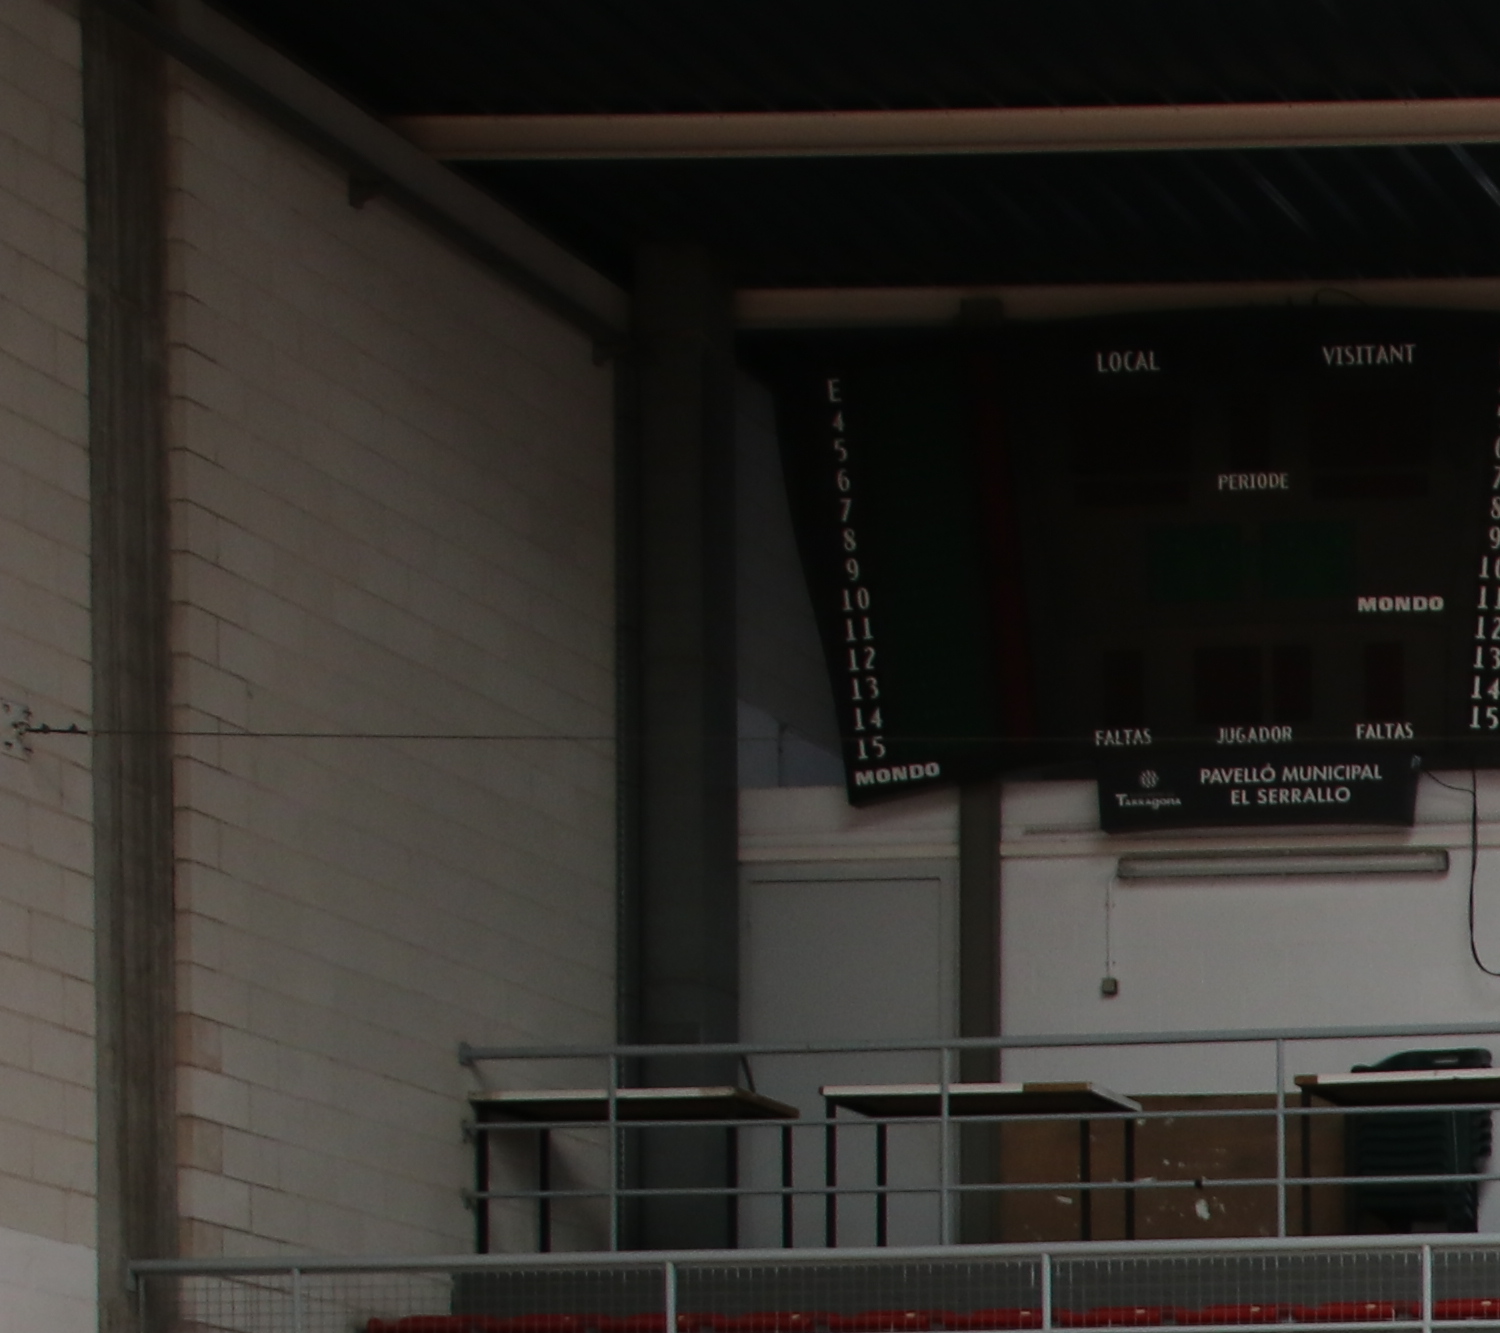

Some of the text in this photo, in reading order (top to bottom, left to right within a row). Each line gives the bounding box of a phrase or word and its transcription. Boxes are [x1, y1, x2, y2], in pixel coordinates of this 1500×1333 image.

[1097, 351, 1160, 373] LOCAL
[1322, 344, 1415, 366] VISITANT
[827, 379, 841, 402] E
[832, 411, 845, 432] 4
[833, 438, 848, 462] 5
[837, 469, 851, 492] 6
[1218, 473, 1289, 491] PERIODE
[840, 498, 852, 522] 7
[843, 528, 857, 552] 8
[845, 558, 860, 581] 9
[843, 587, 870, 611] 10
[1357, 596, 1444, 612] MONDO
[846, 617, 874, 642] 11
[849, 646, 876, 672] 12
[852, 676, 880, 700] 13
[1471, 675, 1500, 700] 14
[855, 707, 883, 731] 14
[1469, 705, 1499, 729] 15
[1095, 728, 1152, 746] FALTAS
[1217, 725, 1293, 744] JUGADOR
[1356, 722, 1414, 740] FALTAS
[858, 735, 886, 760] 15
[855, 762, 940, 786] MONDO
[1200, 763, 1383, 784] PAVELLÓ MUNICIPAL
[1230, 786, 1351, 805] EL SERRALLO
